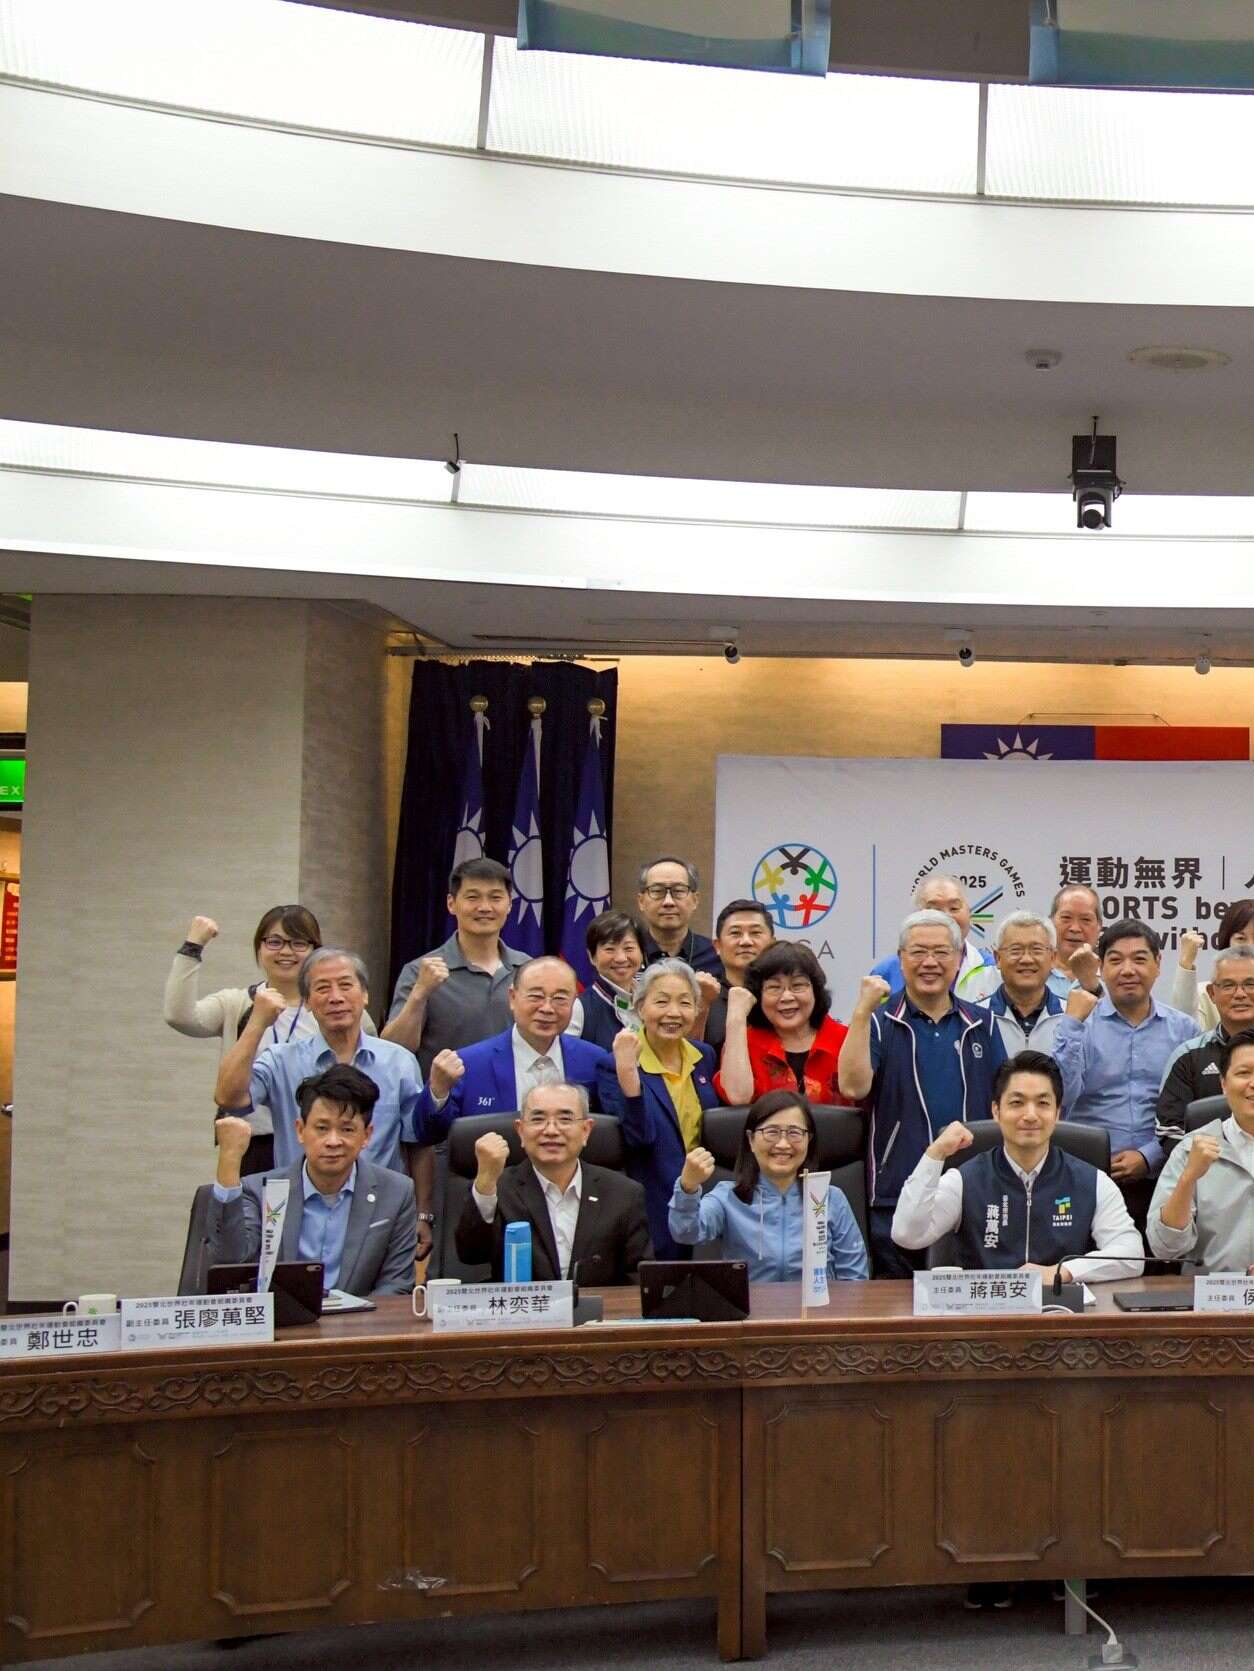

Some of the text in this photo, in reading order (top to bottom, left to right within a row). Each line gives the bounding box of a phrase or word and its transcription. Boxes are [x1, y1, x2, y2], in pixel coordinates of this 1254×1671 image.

[939, 845, 998, 861] MASTERS
[999, 858, 1025, 897] GAMES
[952, 875, 987, 888] 025
[1059, 856, 1202, 888] 運動無界
[1102, 896, 1178, 920] ORTS
[984, 1204, 999, 1249] 蔣萬安
[969, 1281, 1028, 1299] 蔣萬安
[488, 1294, 551, 1315] 林奕華
[174, 1305, 265, 1329] 張廖萬堅
[27, 1328, 98, 1351] 鄭世忠
